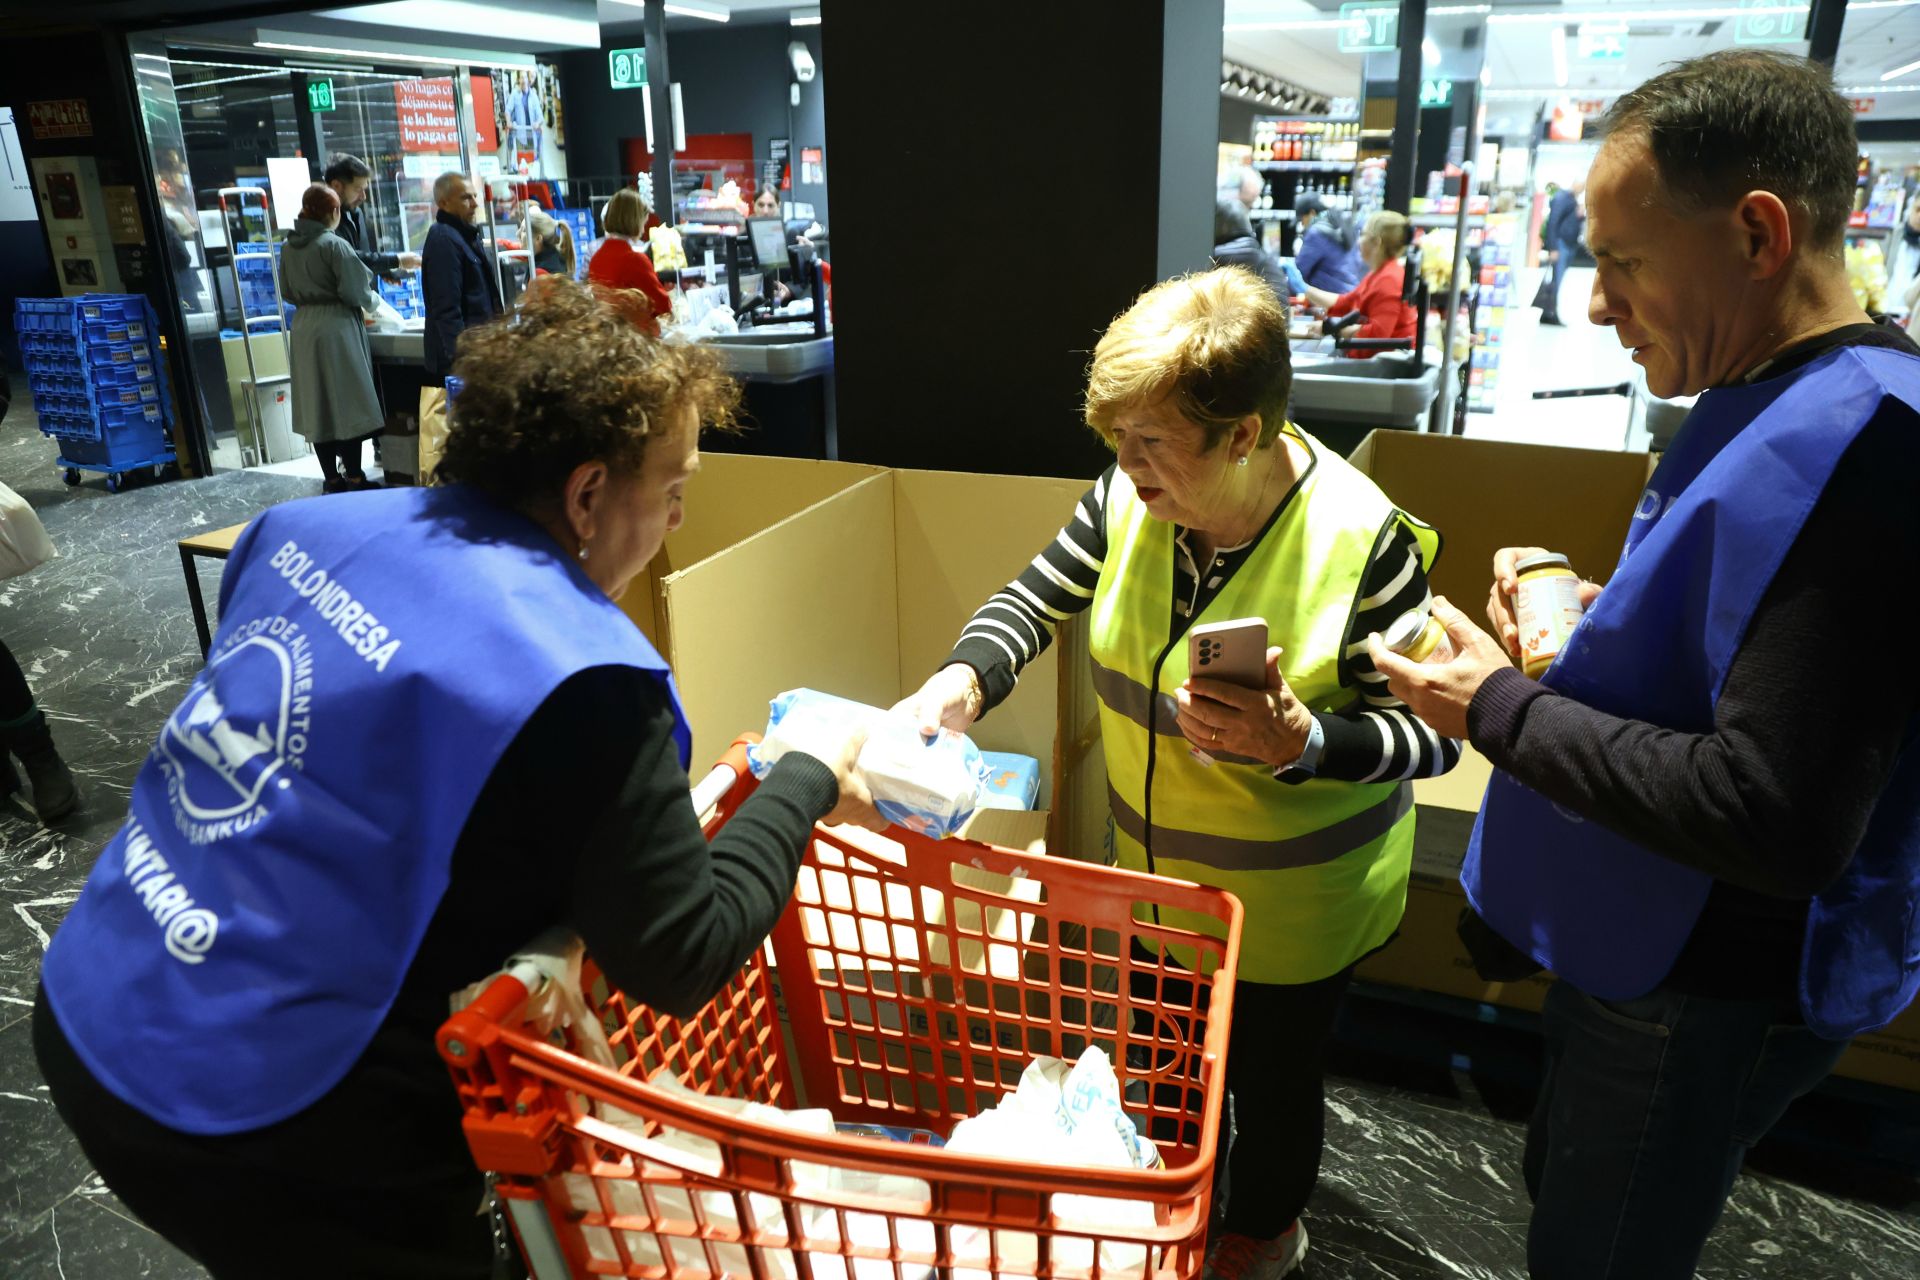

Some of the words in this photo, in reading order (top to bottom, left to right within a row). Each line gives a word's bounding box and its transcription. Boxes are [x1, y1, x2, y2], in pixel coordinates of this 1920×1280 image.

[308, 82, 330, 107] 16
[400, 81, 413, 93] No
[415, 80, 441, 96] hagas
[442, 85, 453, 95] co
[403, 113, 414, 125] te
[414, 112, 425, 126] lo
[404, 128, 416, 141] lo
[416, 131, 446, 144] pagas
[269, 540, 402, 672] BOLONDRESA
[269, 616, 299, 643] DE
[946, 1020, 1013, 1047] LCHE
